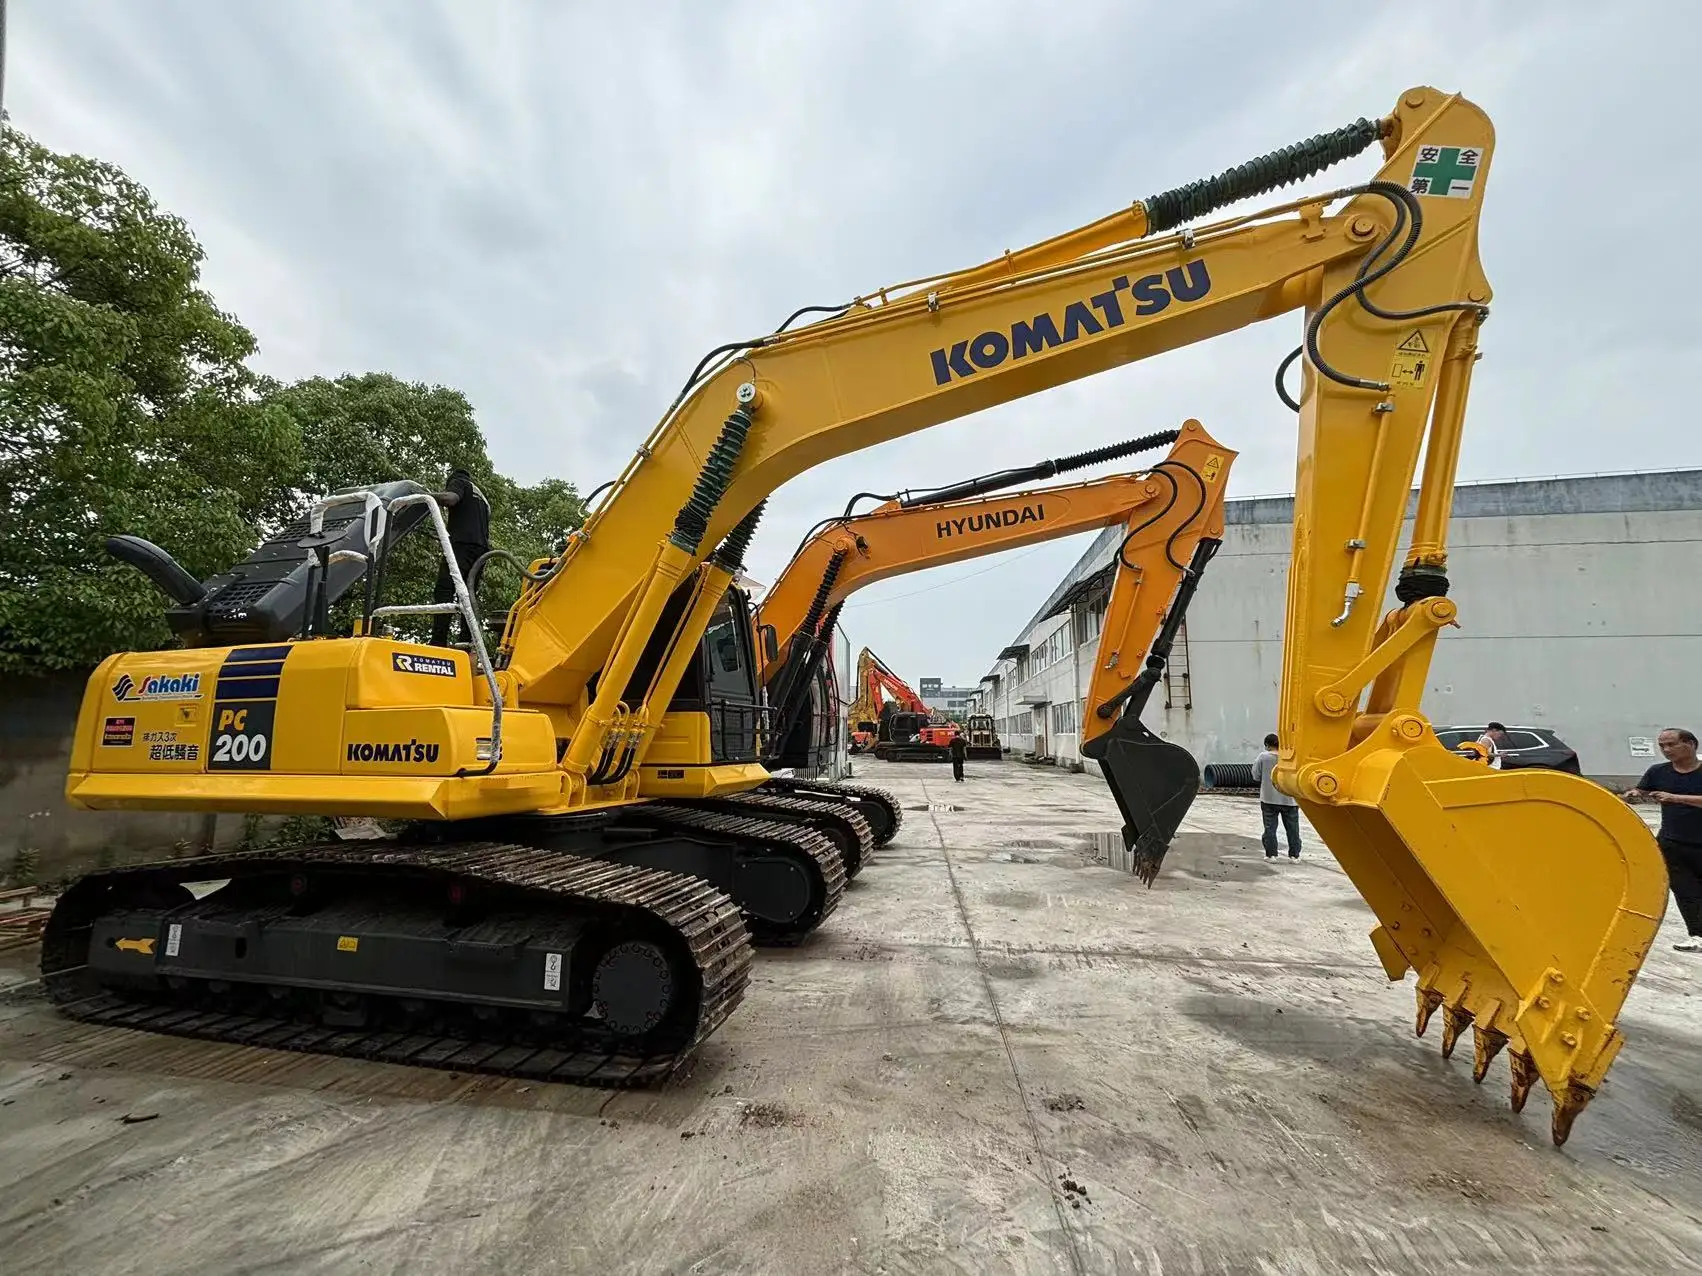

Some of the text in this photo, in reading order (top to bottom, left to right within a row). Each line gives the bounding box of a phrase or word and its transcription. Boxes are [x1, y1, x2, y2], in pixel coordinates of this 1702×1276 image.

[930, 259, 1211, 386] KOMATSU
[936, 504, 1045, 539] HYUNDAI
[414, 657, 451, 666] KOMATSU
[414, 663, 454, 675] RENTAL
[138, 673, 200, 694] Sakaki
[218, 709, 248, 731] PC
[213, 733, 267, 762] 200
[347, 739, 440, 763] KOMATSU
